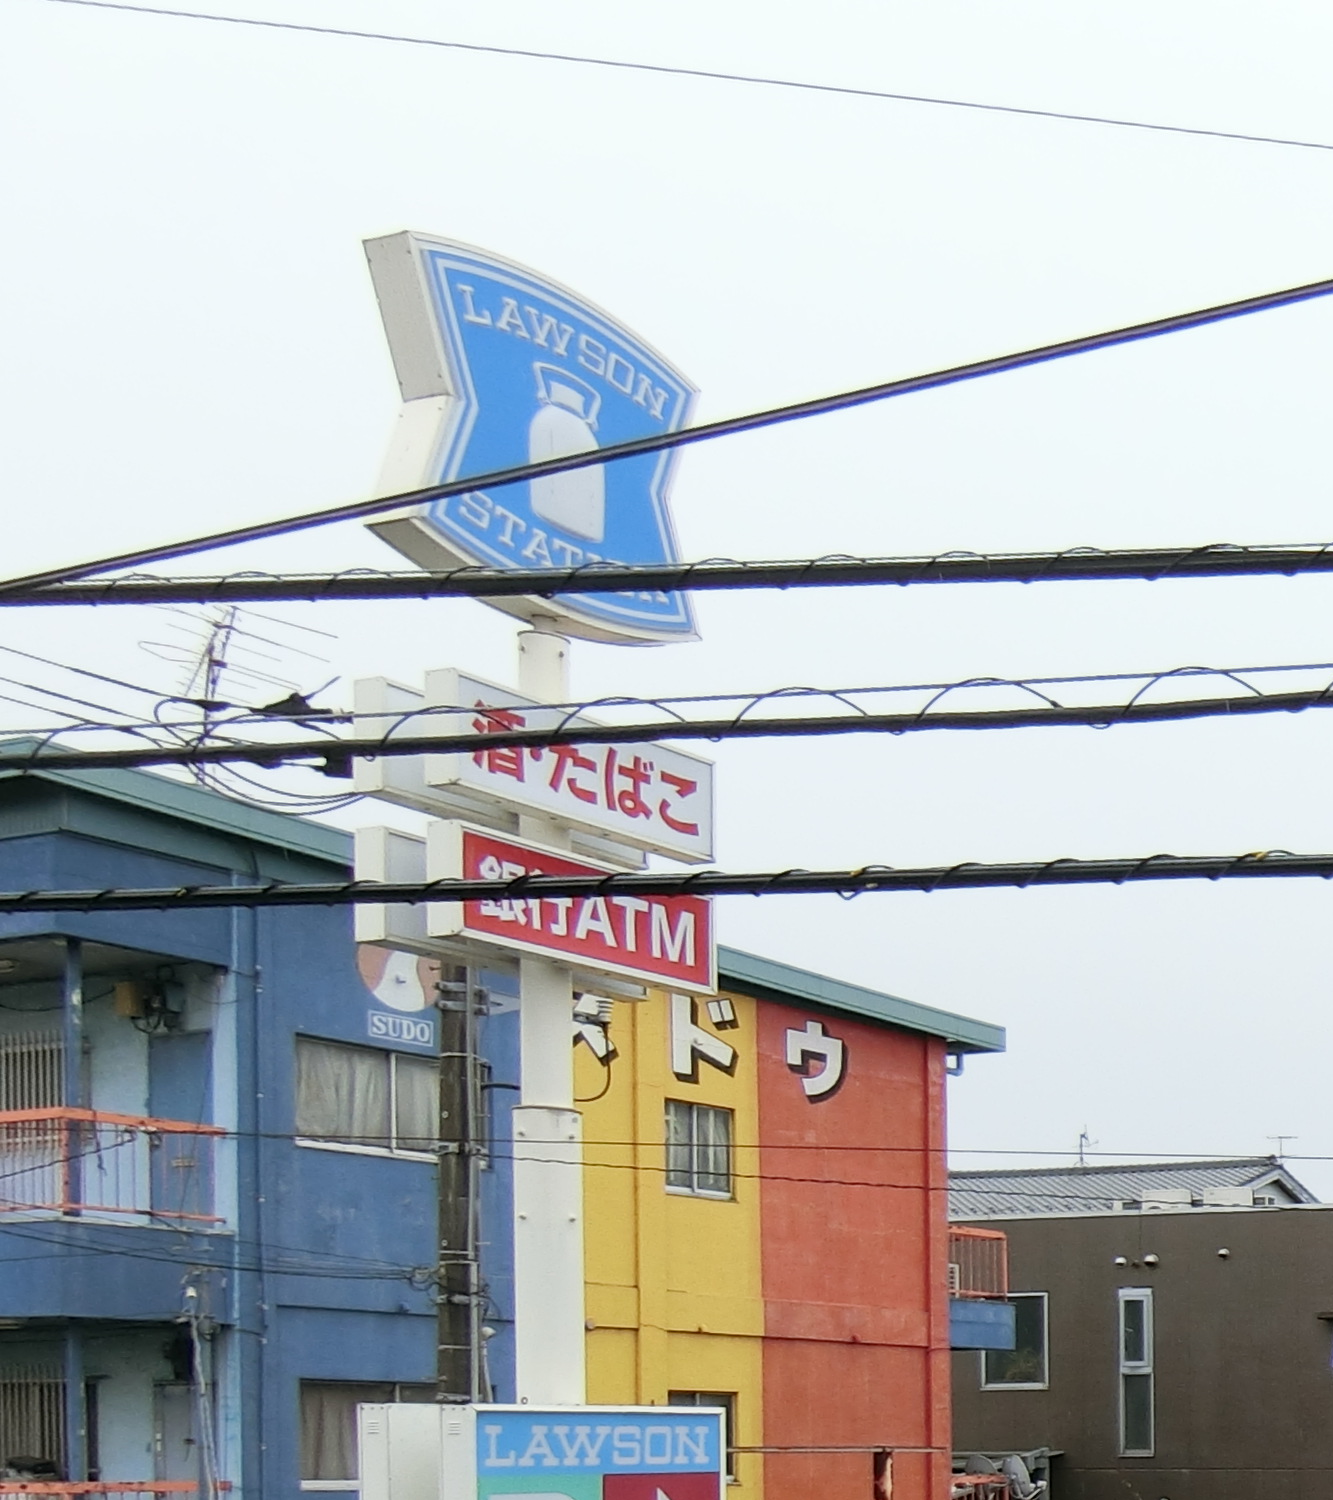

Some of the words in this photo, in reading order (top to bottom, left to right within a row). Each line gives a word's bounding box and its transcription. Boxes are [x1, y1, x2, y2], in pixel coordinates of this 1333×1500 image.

[456, 283, 670, 421] LAWSON
[457, 489, 670, 605] STAT
[372, 1015, 430, 1042] SUDO
[483, 1425, 710, 1467] LAWSON
